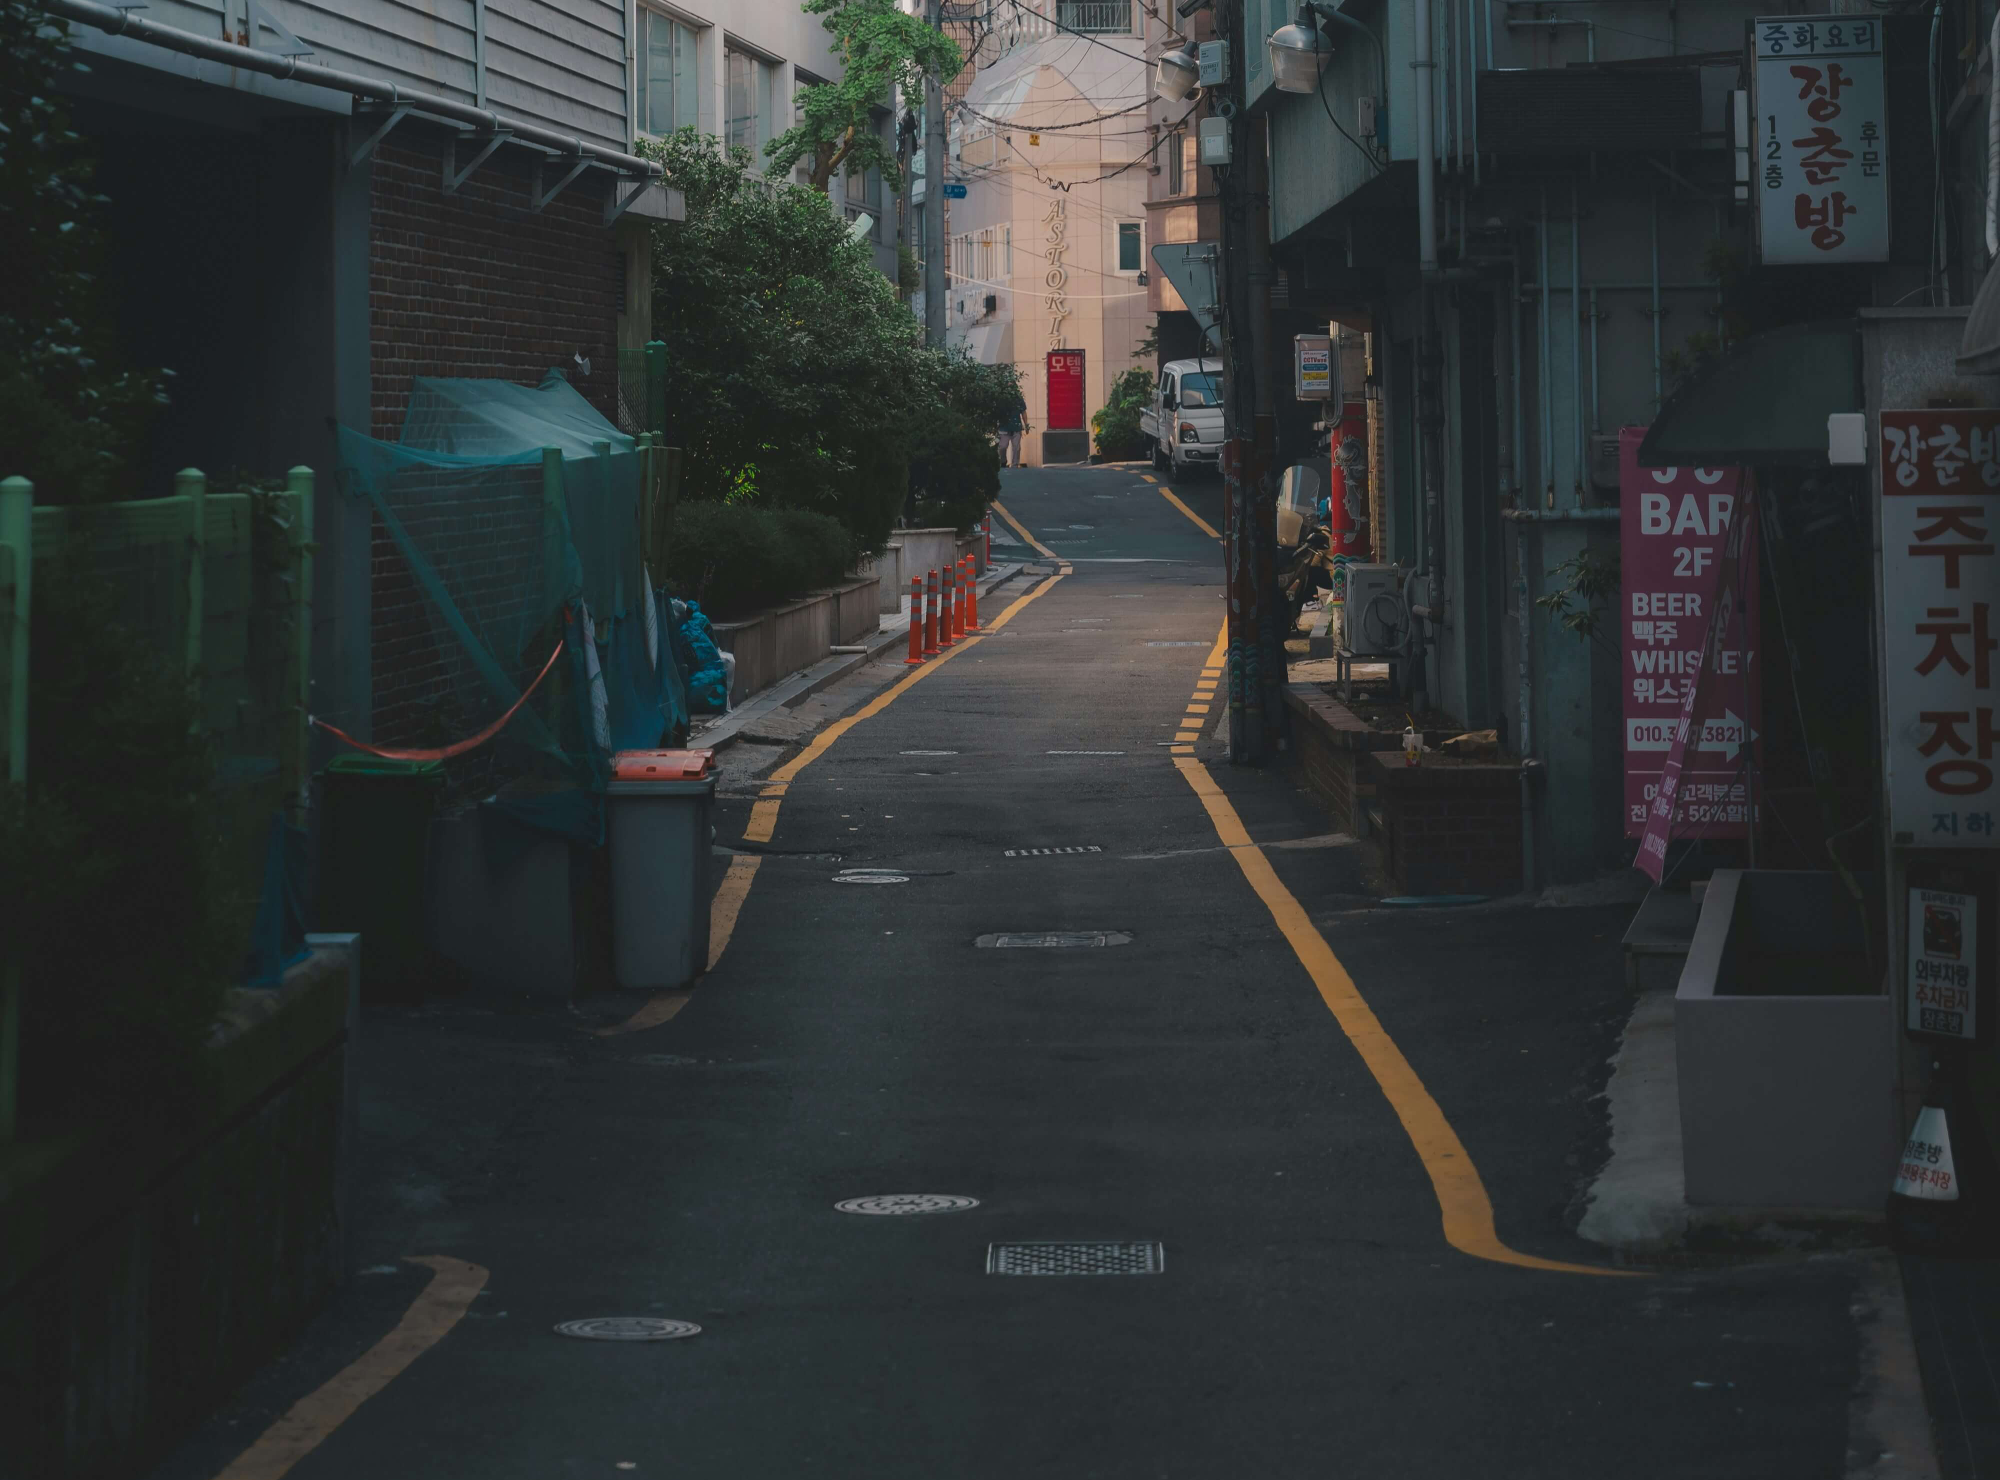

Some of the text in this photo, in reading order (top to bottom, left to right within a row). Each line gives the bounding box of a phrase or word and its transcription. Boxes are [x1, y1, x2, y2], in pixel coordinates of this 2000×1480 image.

[1763, 21, 1877, 53] 중화요리
[1789, 63, 1857, 251] 장춘방
[1859, 121, 1881, 177] 후문
[1050, 356, 1081, 375] 모텔
[1883, 424, 2000, 488] 장춘방
[1673, 547, 1713, 577] 2F
[1632, 593, 1703, 617] BEER
[1632, 621, 1678, 646] 맥주
[1631, 651, 1755, 675] WHISEY
[1908, 506, 2000, 796] 주차장
[1932, 811, 1996, 837] 지하
[1915, 959, 1970, 988] 외부차량
[1915, 983, 1970, 1012] 주차금지
[1923, 1010, 1961, 1032] 장춘방
